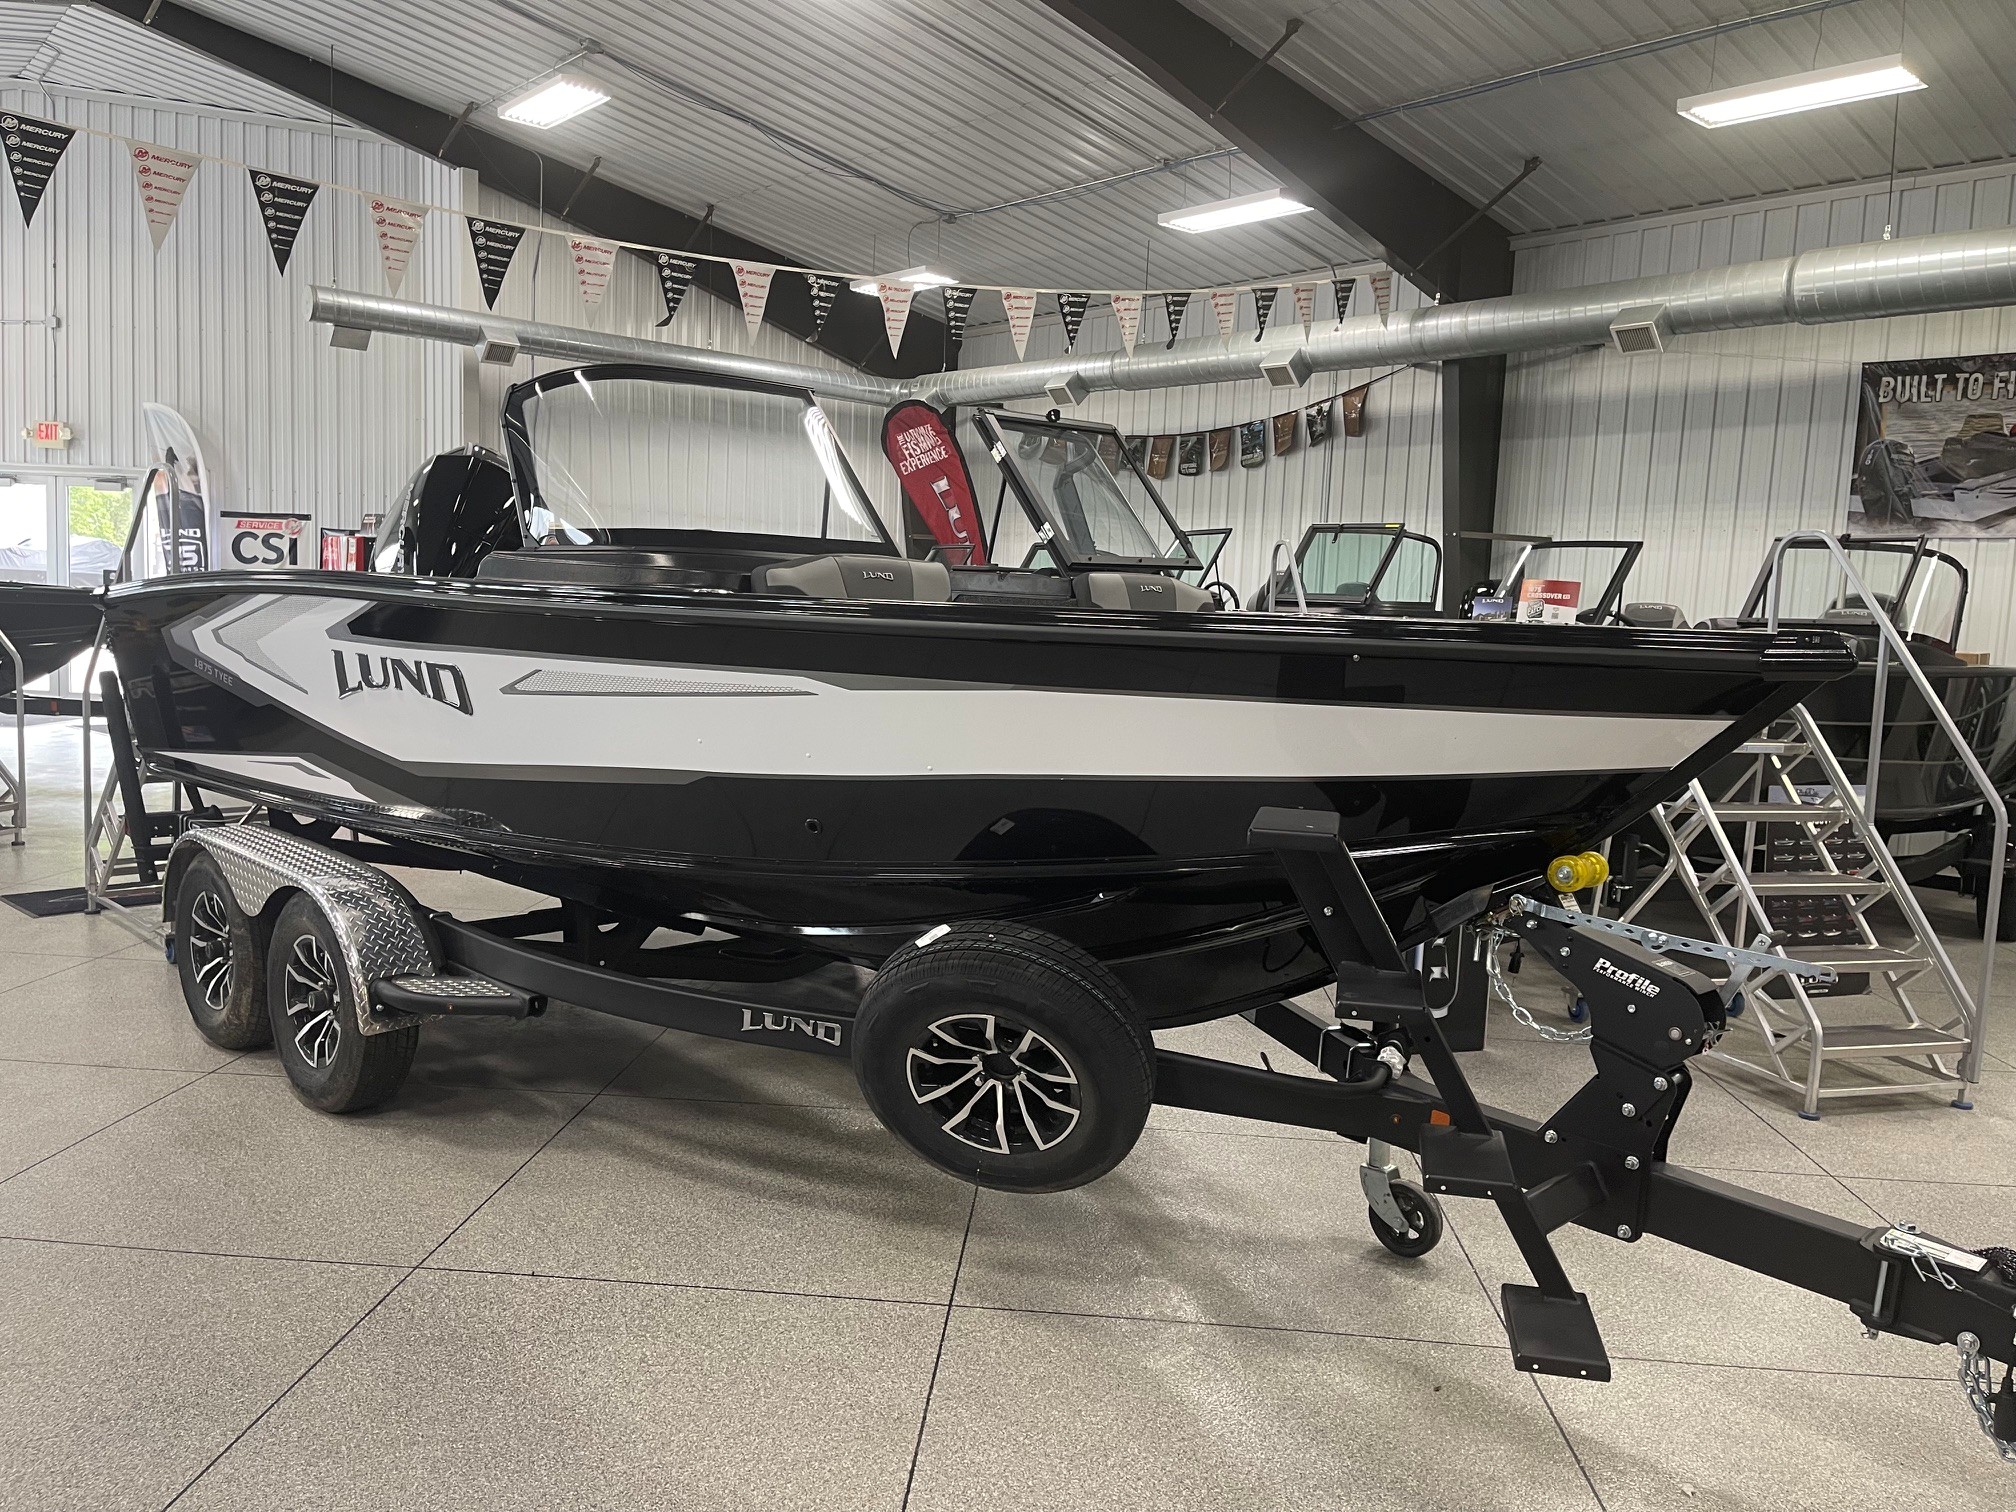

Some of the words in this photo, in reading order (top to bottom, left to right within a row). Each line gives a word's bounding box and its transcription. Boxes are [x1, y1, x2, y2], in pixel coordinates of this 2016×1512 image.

[20, 124, 69, 139] MERCURY
[21, 141, 61, 154] MERCURY
[22, 157, 55, 167] MERCURY
[151, 155, 193, 169] MERCURY
[152, 171, 187, 183] MERCURY
[272, 181, 314, 194] MERCURY
[274, 197, 308, 208] MERCURY
[385, 206, 422, 218] MERCURY
[485, 226, 520, 238] MERCURY
[486, 241, 515, 250] MERCURY
[583, 245, 613, 255] MERCURY
[669, 258, 697, 269] MERCURY
[745, 269, 771, 278] MERCURY
[1879, 373, 1948, 403] BUILT
[1956, 372, 1984, 401] TO
[38, 423, 58, 441] EXIT
[901, 430, 942, 460] FISHING
[899, 445, 949, 476] EXPERIENCE
[239, 521, 281, 530] SERVICE
[160, 528, 201, 538] LND
[231, 530, 299, 566] CSI
[862, 571, 894, 581] LUND
[1140, 585, 1163, 593] LUND
[1527, 592, 1562, 600] CROSSOVER
[194, 658, 213, 675] 1875
[214, 668, 233, 687] TYEE
[331, 649, 474, 716] LUND
[1592, 966, 1634, 989] PERFORMANCE
[1634, 986, 1656, 998] WINCH
[1594, 957, 1661, 996] Profile
[741, 1008, 842, 1047] LUND
